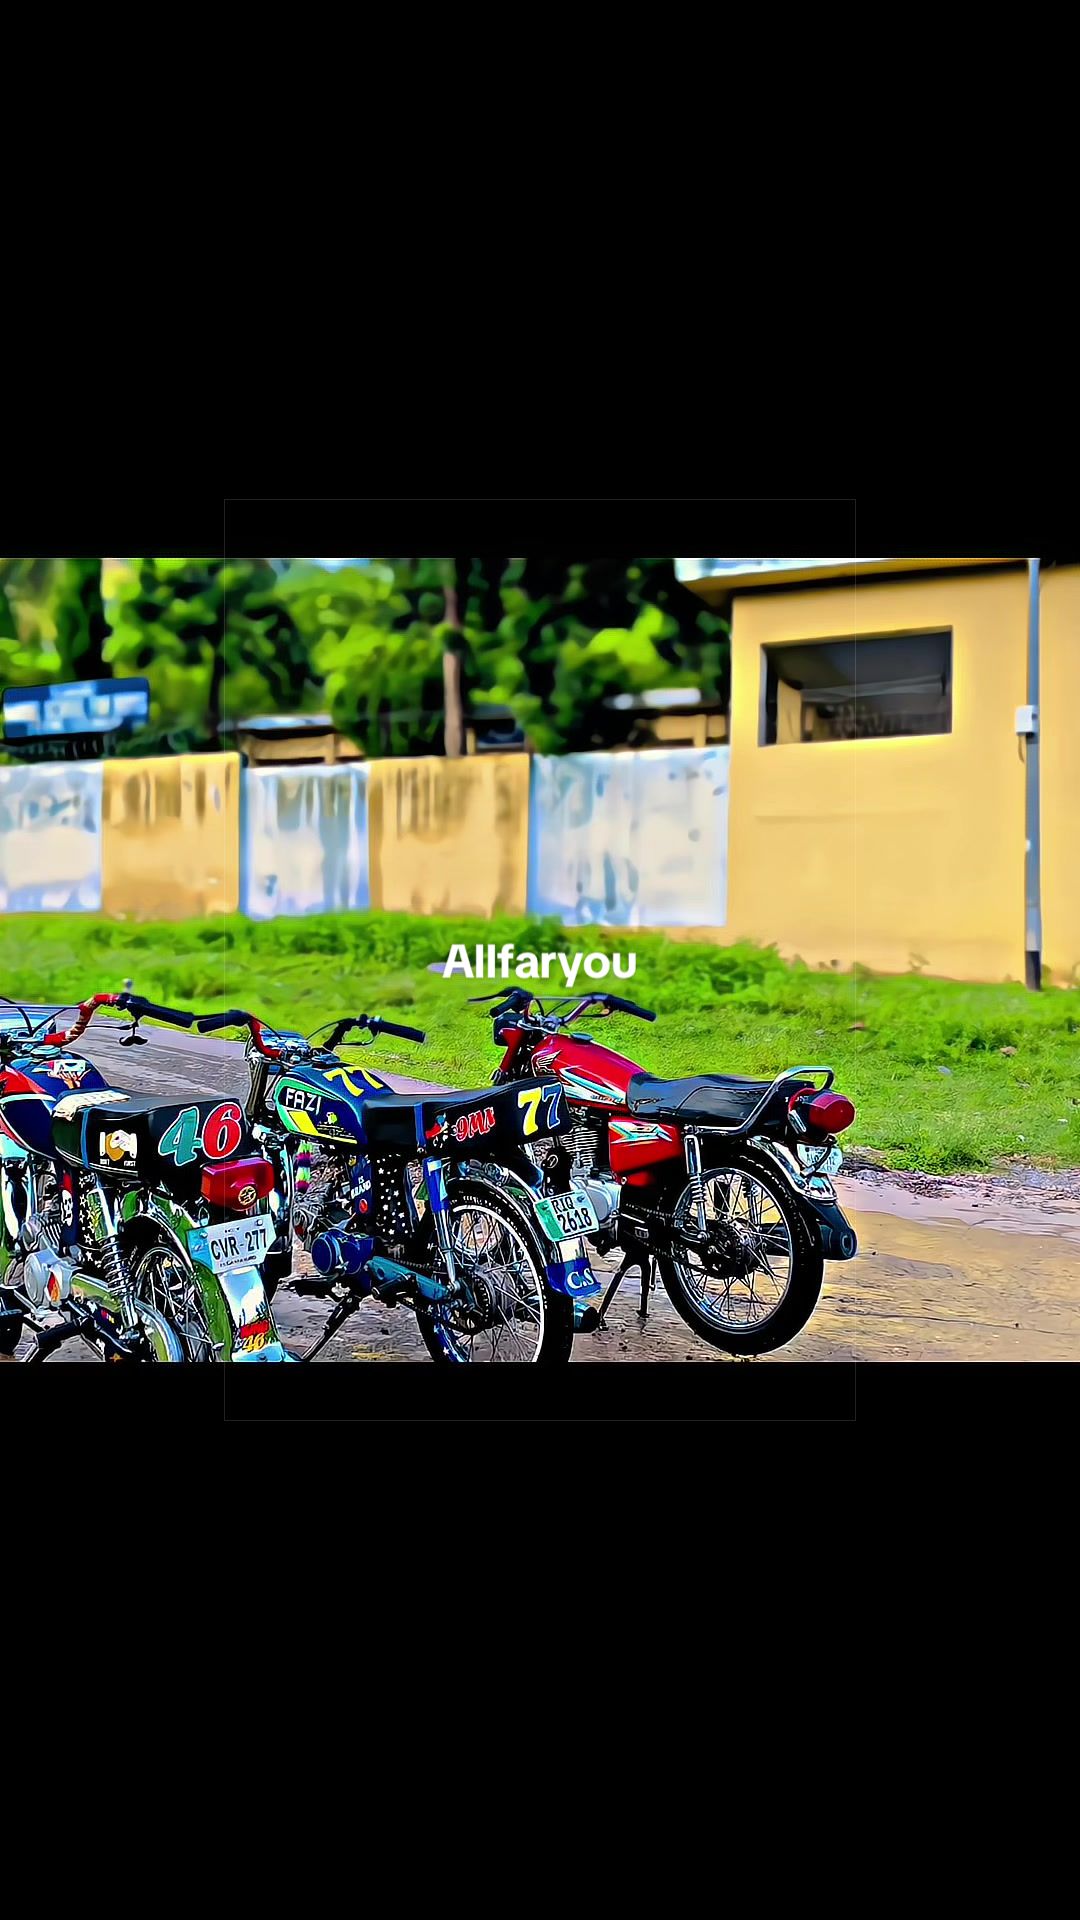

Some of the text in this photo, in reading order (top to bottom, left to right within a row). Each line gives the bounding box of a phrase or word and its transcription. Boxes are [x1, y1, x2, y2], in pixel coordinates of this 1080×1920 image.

[322, 1066, 384, 1097] 77
[285, 1087, 322, 1115] FAZI
[518, 1082, 562, 1136] 77
[158, 1101, 242, 1166] 46
[551, 1196, 575, 1214] RIQ
[557, 1208, 593, 1233] 2618
[210, 1228, 267, 1260] CVR-277
